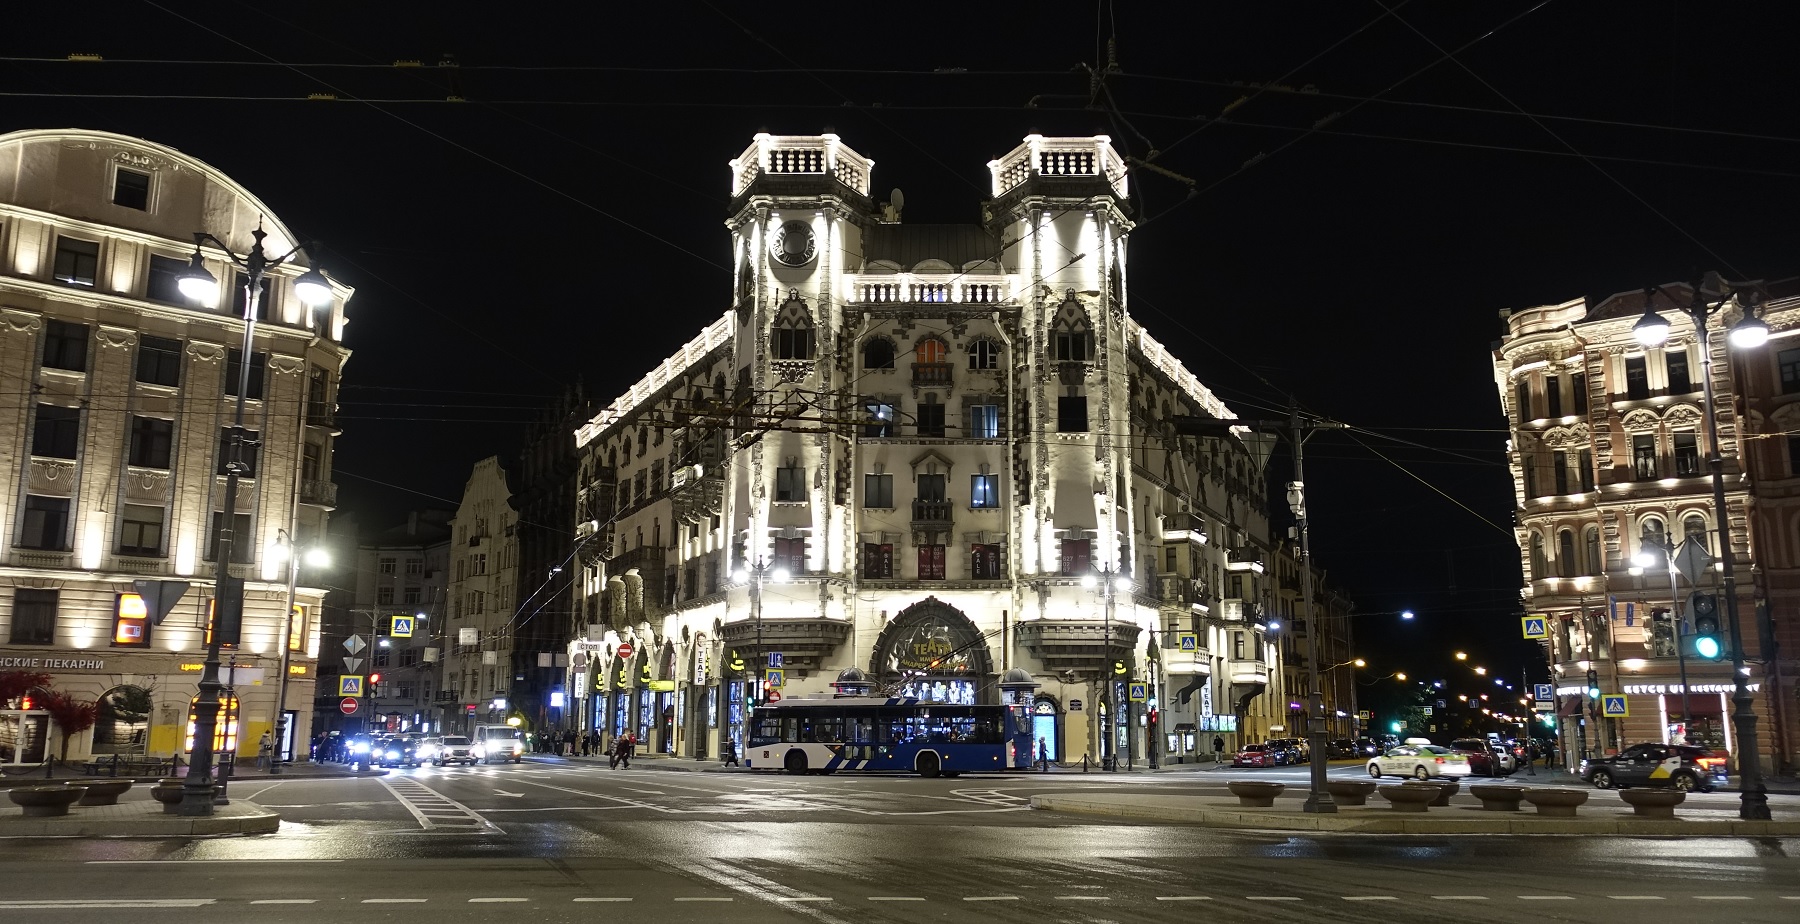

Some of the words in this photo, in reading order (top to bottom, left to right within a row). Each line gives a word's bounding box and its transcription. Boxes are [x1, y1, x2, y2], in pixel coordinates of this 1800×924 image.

[914, 638, 952, 655] ТЕАТР
[44, 658, 104, 669] ПЕКАРНИ
[290, 665, 306, 674] DNS
[1623, 685, 1666, 694] KETCH
[1690, 683, 1760, 693] RESTAURNT
